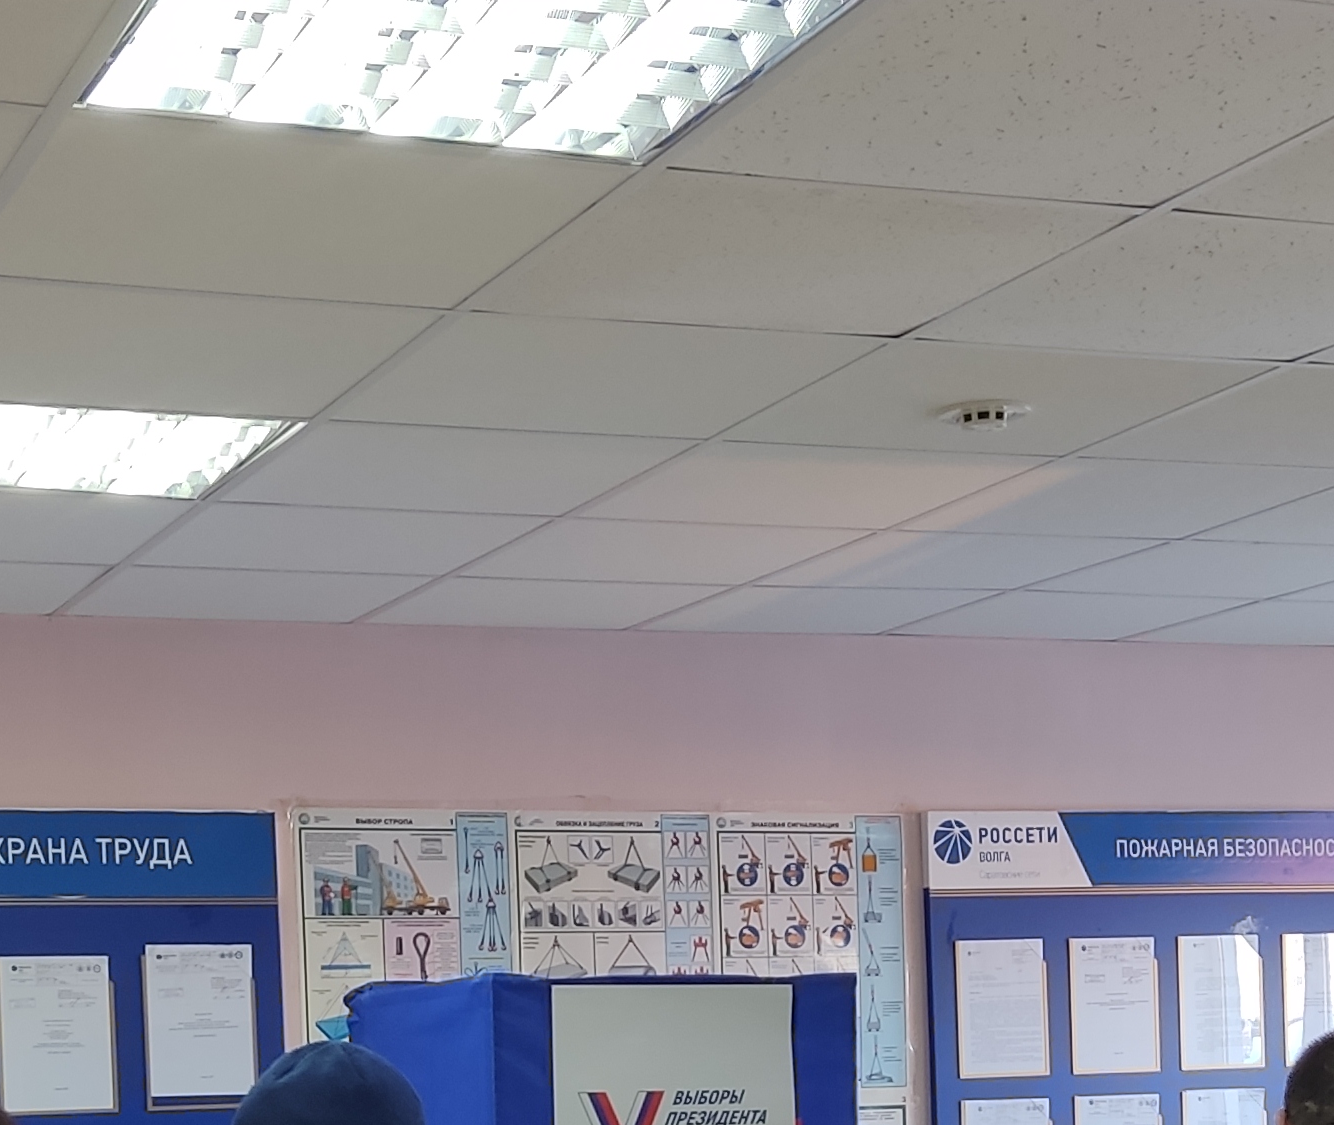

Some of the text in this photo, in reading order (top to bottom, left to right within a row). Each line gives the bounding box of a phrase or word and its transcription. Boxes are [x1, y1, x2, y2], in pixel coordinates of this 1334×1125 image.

[978, 826, 1058, 844] РОССЕТИ
[94, 838, 194, 869] ТРУДА
[979, 851, 1011, 863] ВОЛГА
[1116, 838, 1218, 858] ПОЖАРНАЯ
[672, 1089, 746, 1106] ВЫБОРЫ
